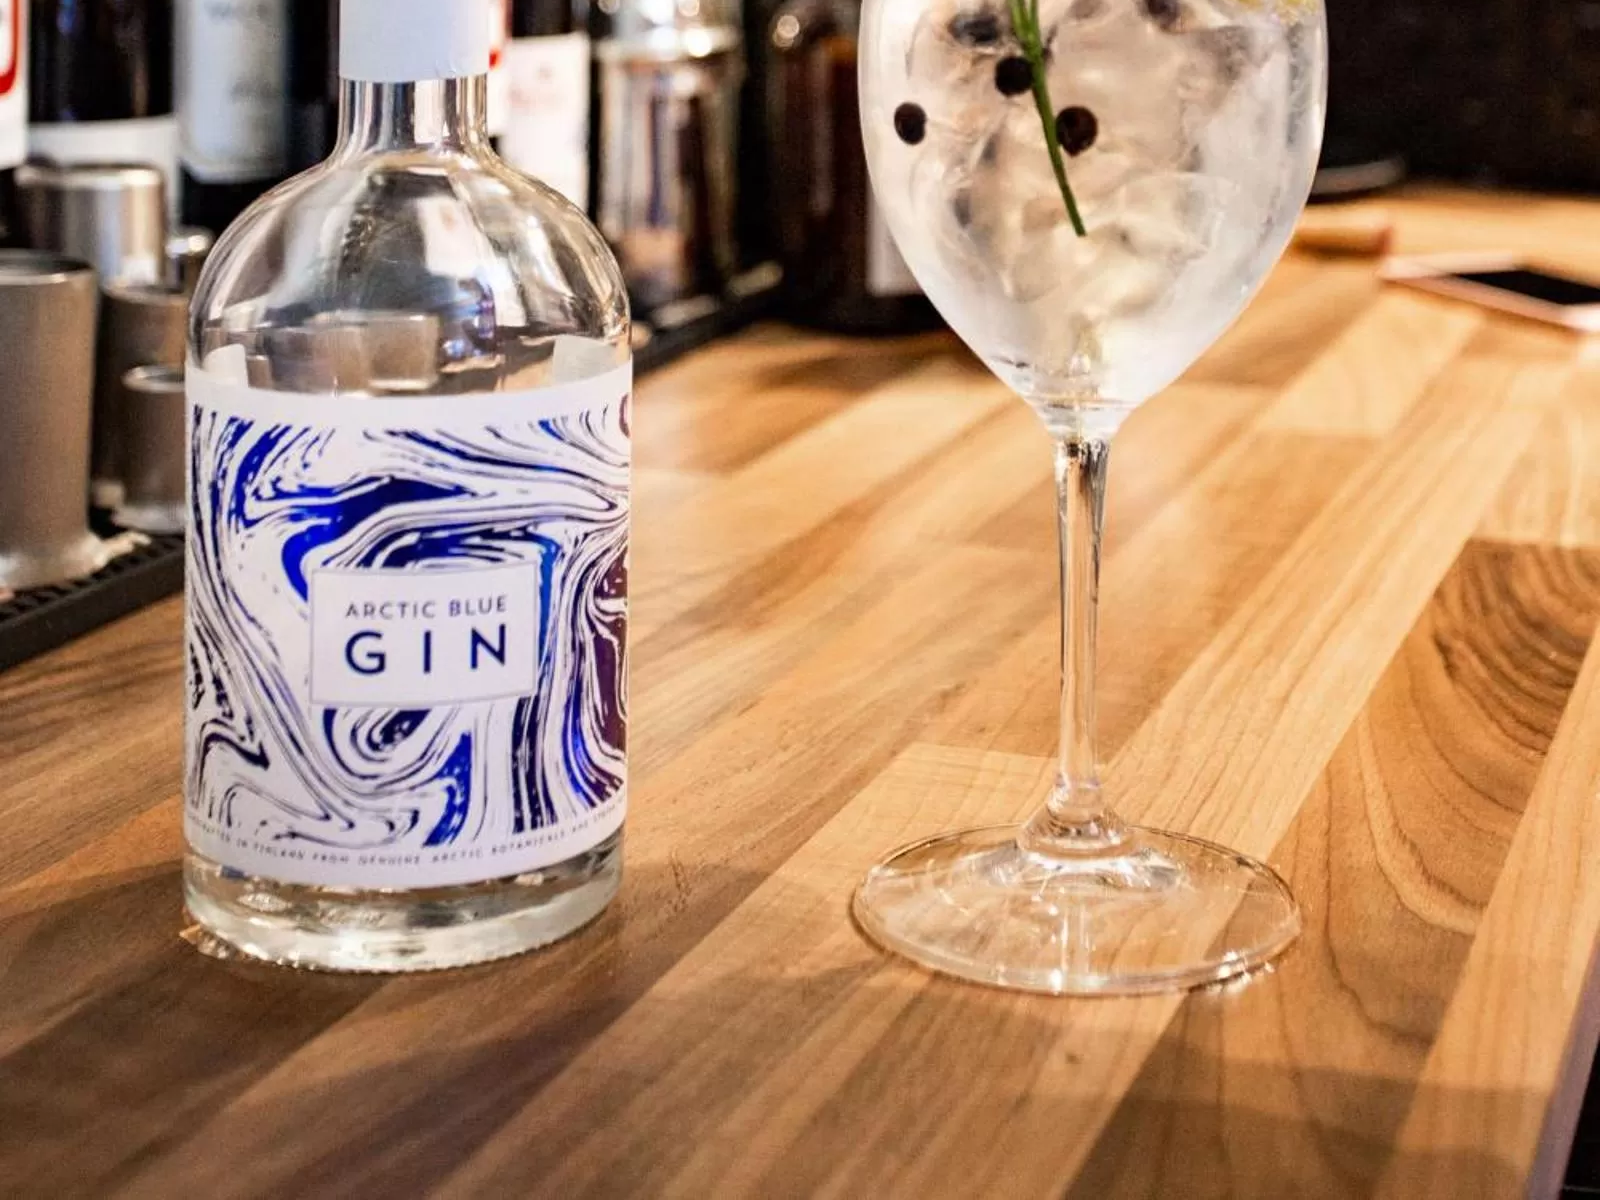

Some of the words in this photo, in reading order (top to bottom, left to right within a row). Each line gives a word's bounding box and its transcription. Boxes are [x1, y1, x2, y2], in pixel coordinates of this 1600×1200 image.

[345, 600, 437, 620] ARCTIC
[448, 595, 507, 617] BLUE
[345, 623, 507, 676] GIN
